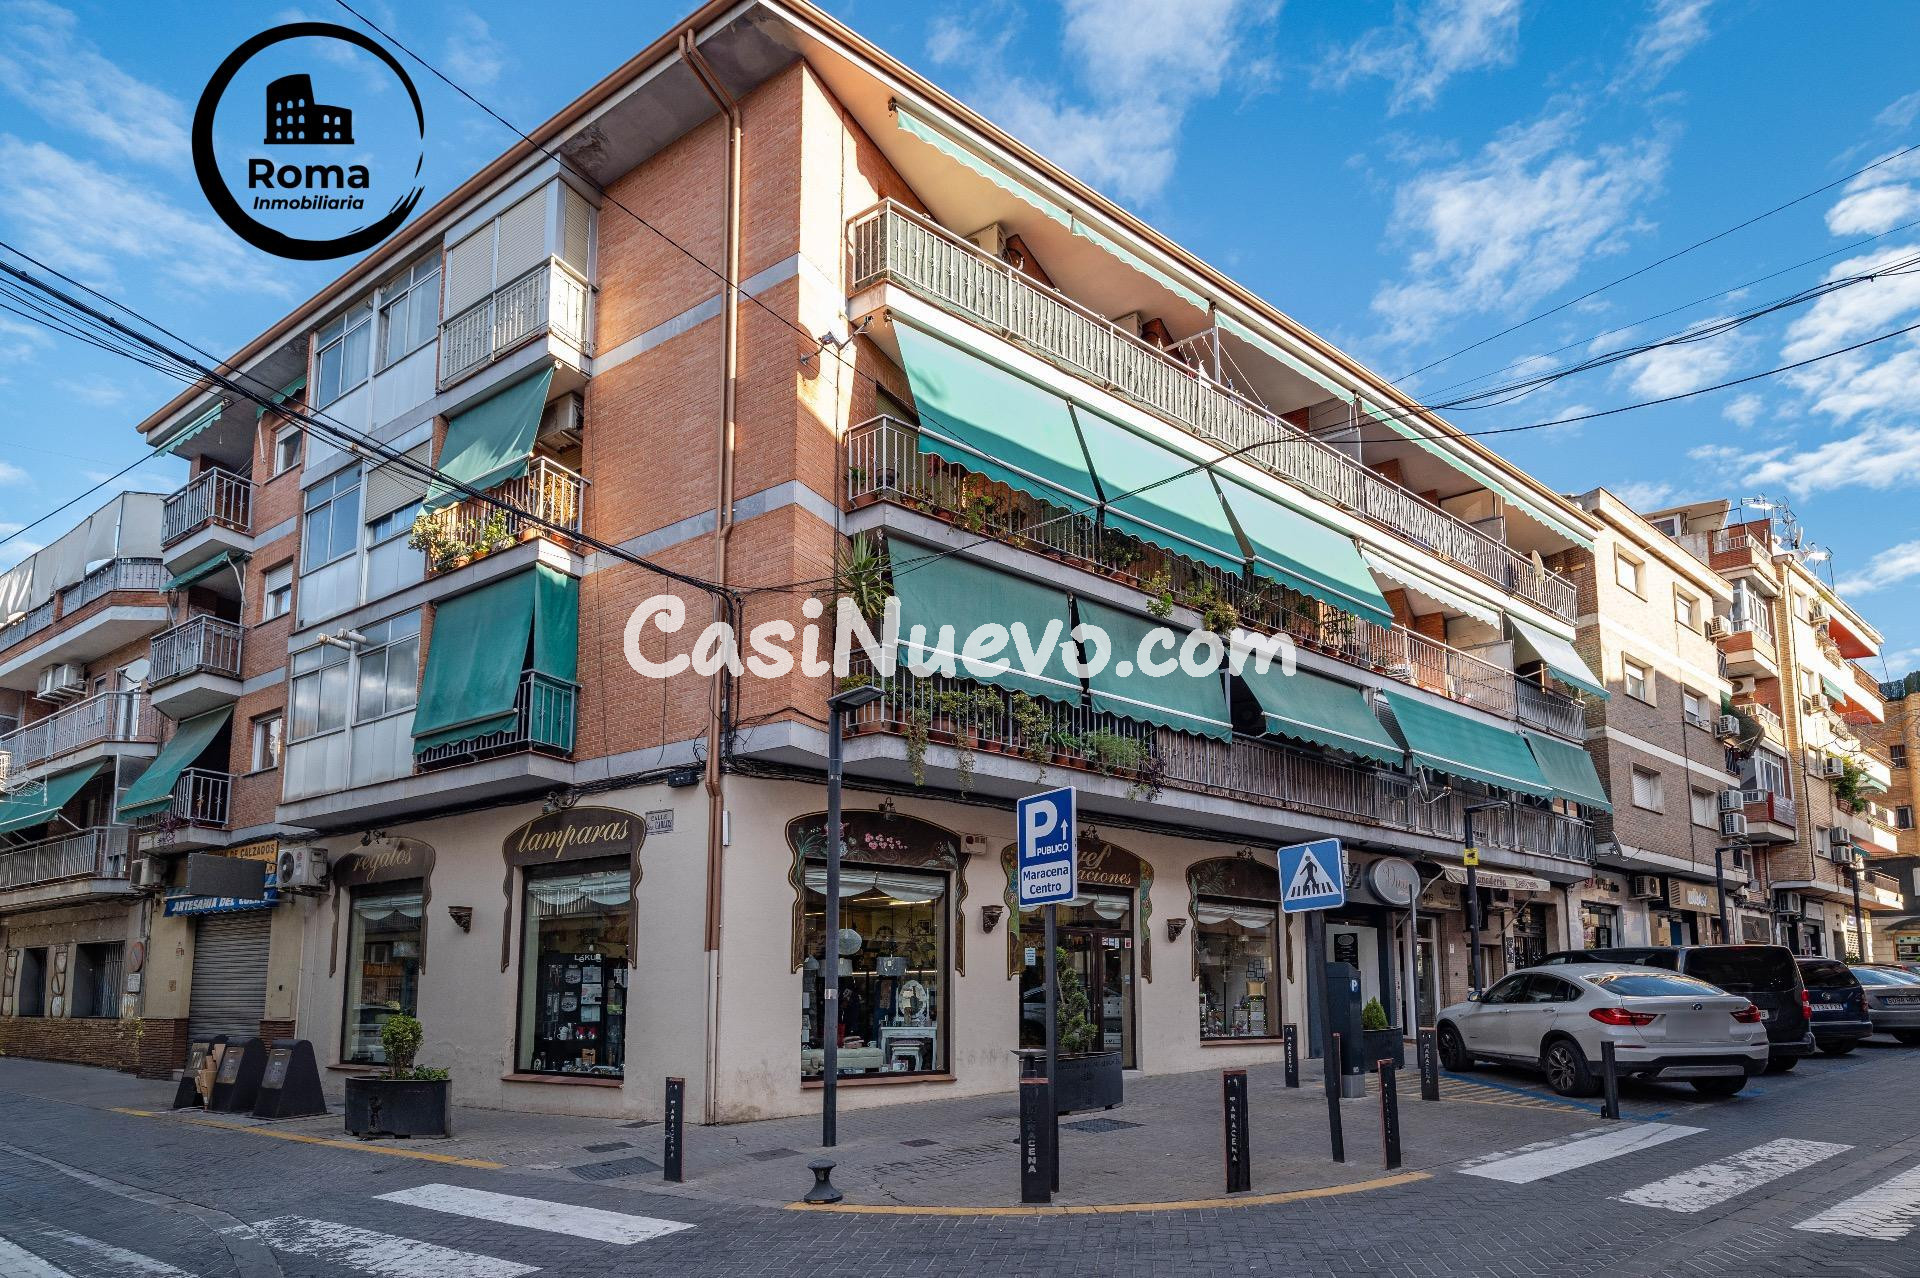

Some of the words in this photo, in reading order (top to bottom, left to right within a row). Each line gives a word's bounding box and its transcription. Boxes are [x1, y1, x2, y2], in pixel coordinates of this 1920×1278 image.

[1026, 800, 1057, 858] P
[516, 819, 629, 858] lamparas
[240, 843, 275, 857] CALZADOS
[1036, 842, 1069, 856] PUBLICO
[353, 847, 412, 881] regalos
[1023, 865, 1069, 881] Maracena
[1077, 868, 1132, 885] aciones
[1029, 881, 1062, 895] Centro
[219, 897, 235, 907] DEL
[1351, 979, 1358, 992] P
